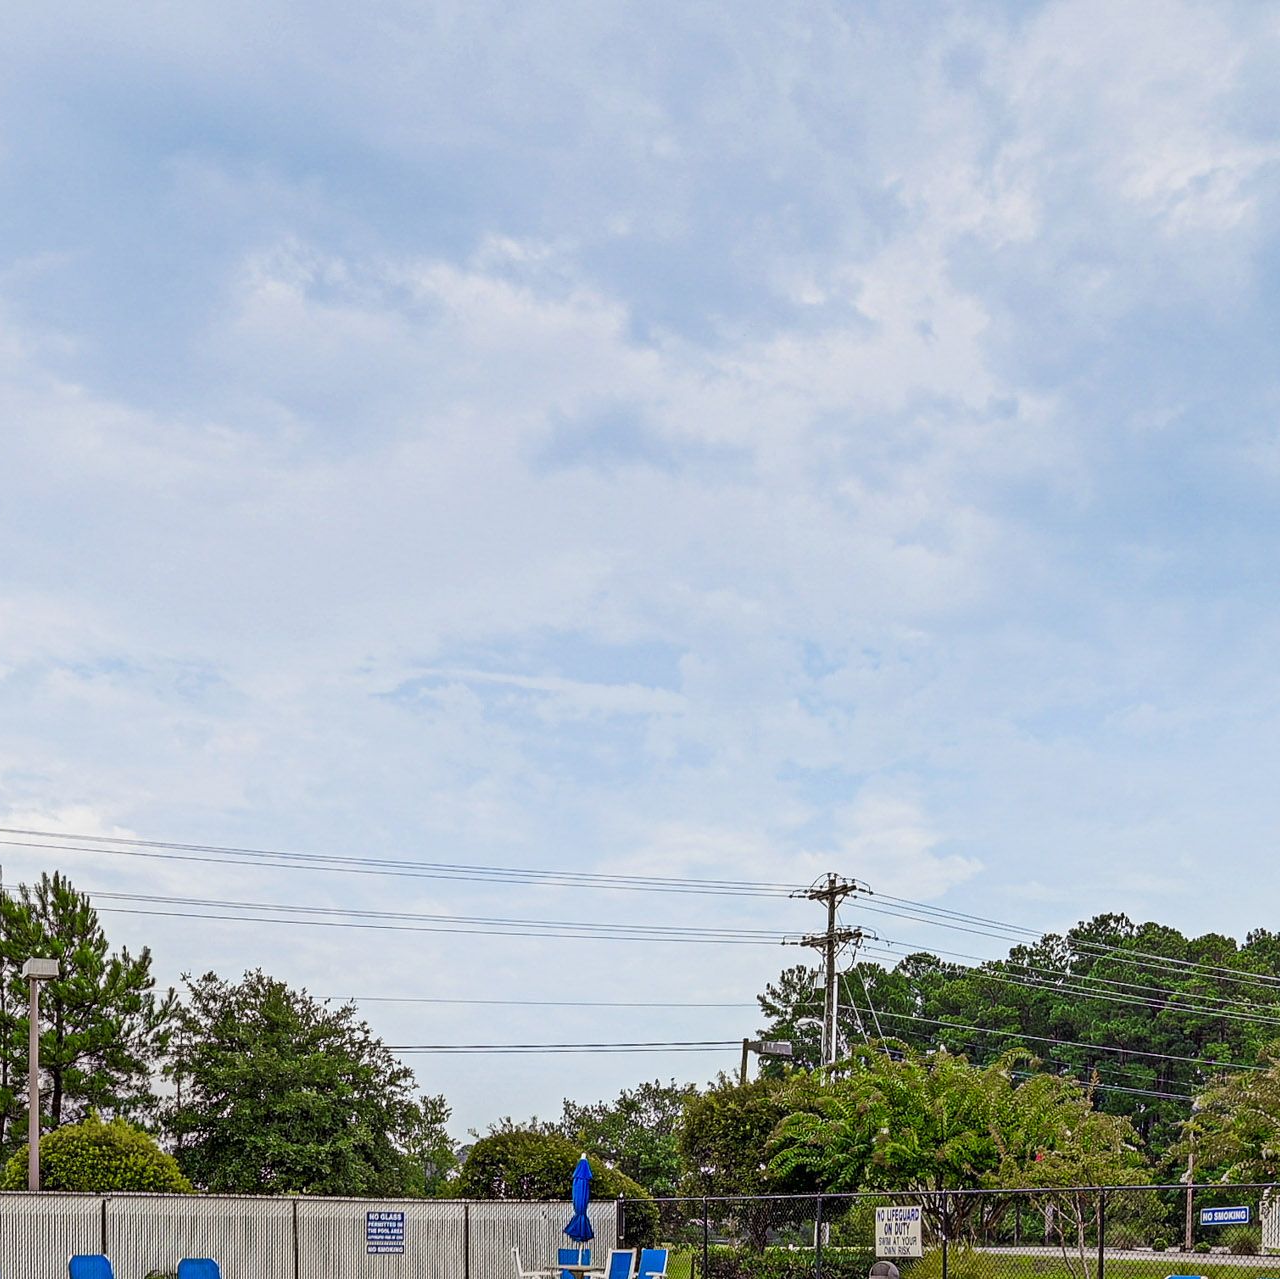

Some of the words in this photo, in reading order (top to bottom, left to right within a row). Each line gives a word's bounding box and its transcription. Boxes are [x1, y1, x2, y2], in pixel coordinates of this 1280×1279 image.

[369, 1213, 380, 1221] NO
[380, 1213, 402, 1221] GLASS
[877, 1210, 885, 1222] NO
[887, 1208, 919, 1222] LIFEGUARD
[1202, 1212, 1213, 1222] NO
[1213, 1210, 1246, 1221] SMOKING
[884, 1223, 893, 1236] ON
[894, 1222, 910, 1236] DUTY
[879, 1237, 891, 1246] SWIM
[893, 1237, 900, 1246] AT
[902, 1236, 917, 1246] YOUR
[884, 1247, 896, 1255] OWN
[898, 1246, 911, 1255] RISK
